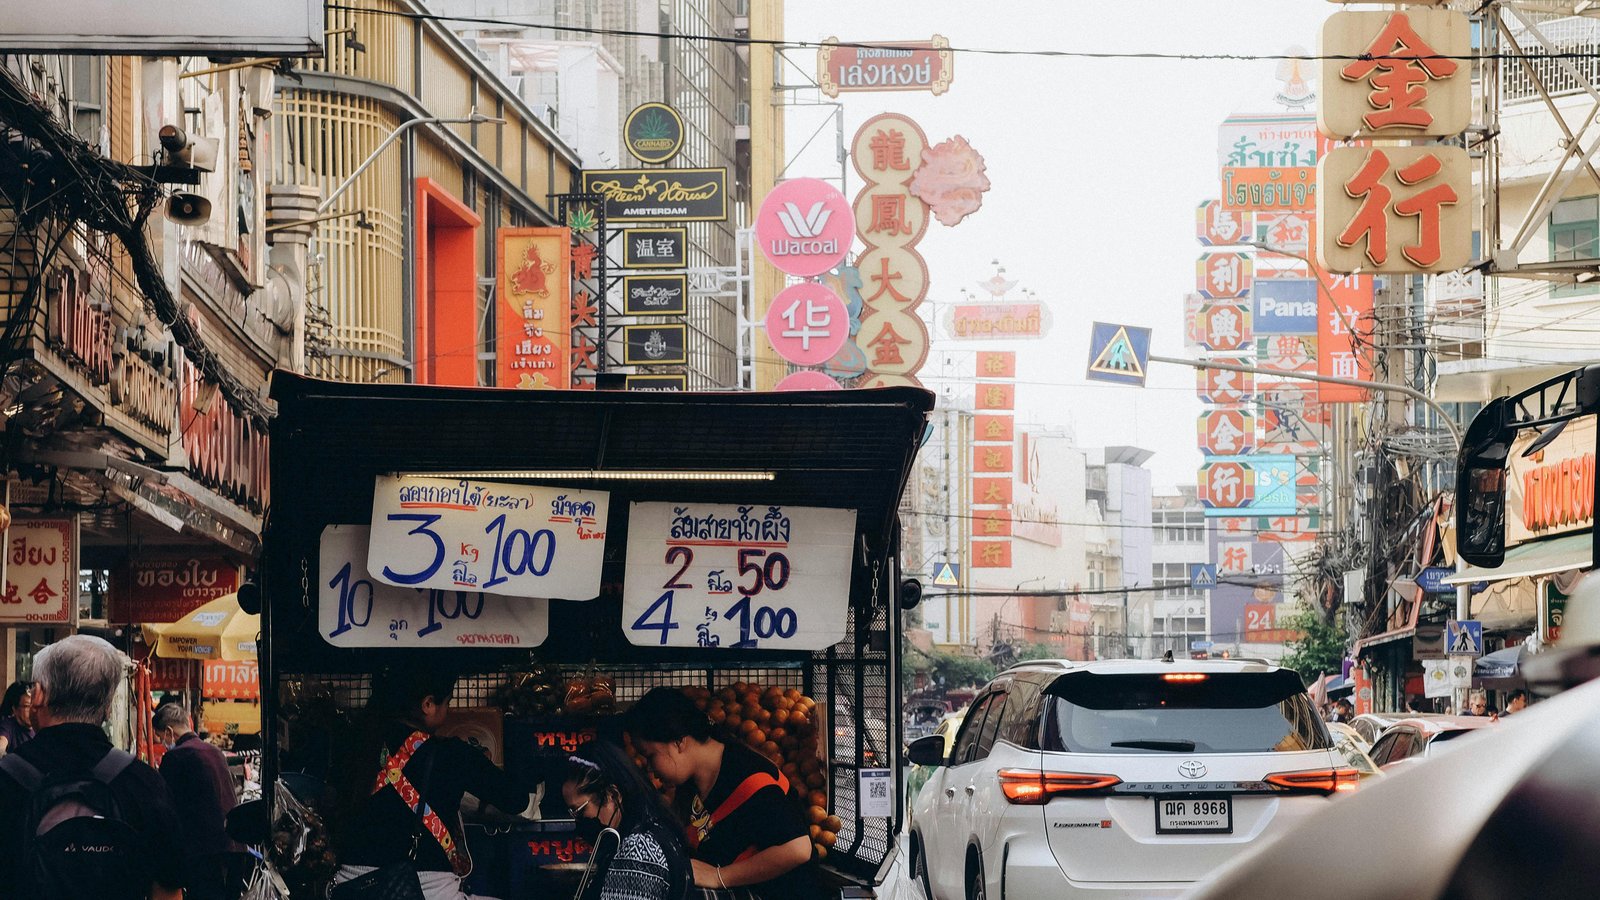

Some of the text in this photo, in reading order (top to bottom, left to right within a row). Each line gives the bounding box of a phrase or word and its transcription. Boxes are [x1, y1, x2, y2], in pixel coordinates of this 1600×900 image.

[840, 56, 931, 86] เล่งหงษ์
[638, 140, 671, 149] CANNABIS
[1336, 10, 1460, 268] 金行
[658, 179, 718, 202] House
[623, 207, 687, 216] AMSTERDAM
[635, 238, 675, 258] 温室
[772, 238, 838, 256] Wacoal
[867, 128, 913, 387] 龍鳳大金
[1259, 297, 1318, 316] Pana
[551, 494, 596, 526] มังคุด
[670, 506, 791, 542] ส้มสายน้ำผึ้ง
[7, 537, 57, 566] ฮียง
[382, 513, 446, 585] 3
[482, 513, 557, 589] 100
[663, 546, 694, 589] 2
[737, 548, 791, 596] 50
[329, 561, 485, 640] 10 ลูก 100
[631, 590, 680, 645] 4
[723, 594, 798, 648] 100
[1247, 610, 1272, 631] 24
[194, 646, 213, 654] VOICE
[1193, 801, 1227, 815] 8968
[1169, 820, 1219, 829] กรุงเทพมหานคร
